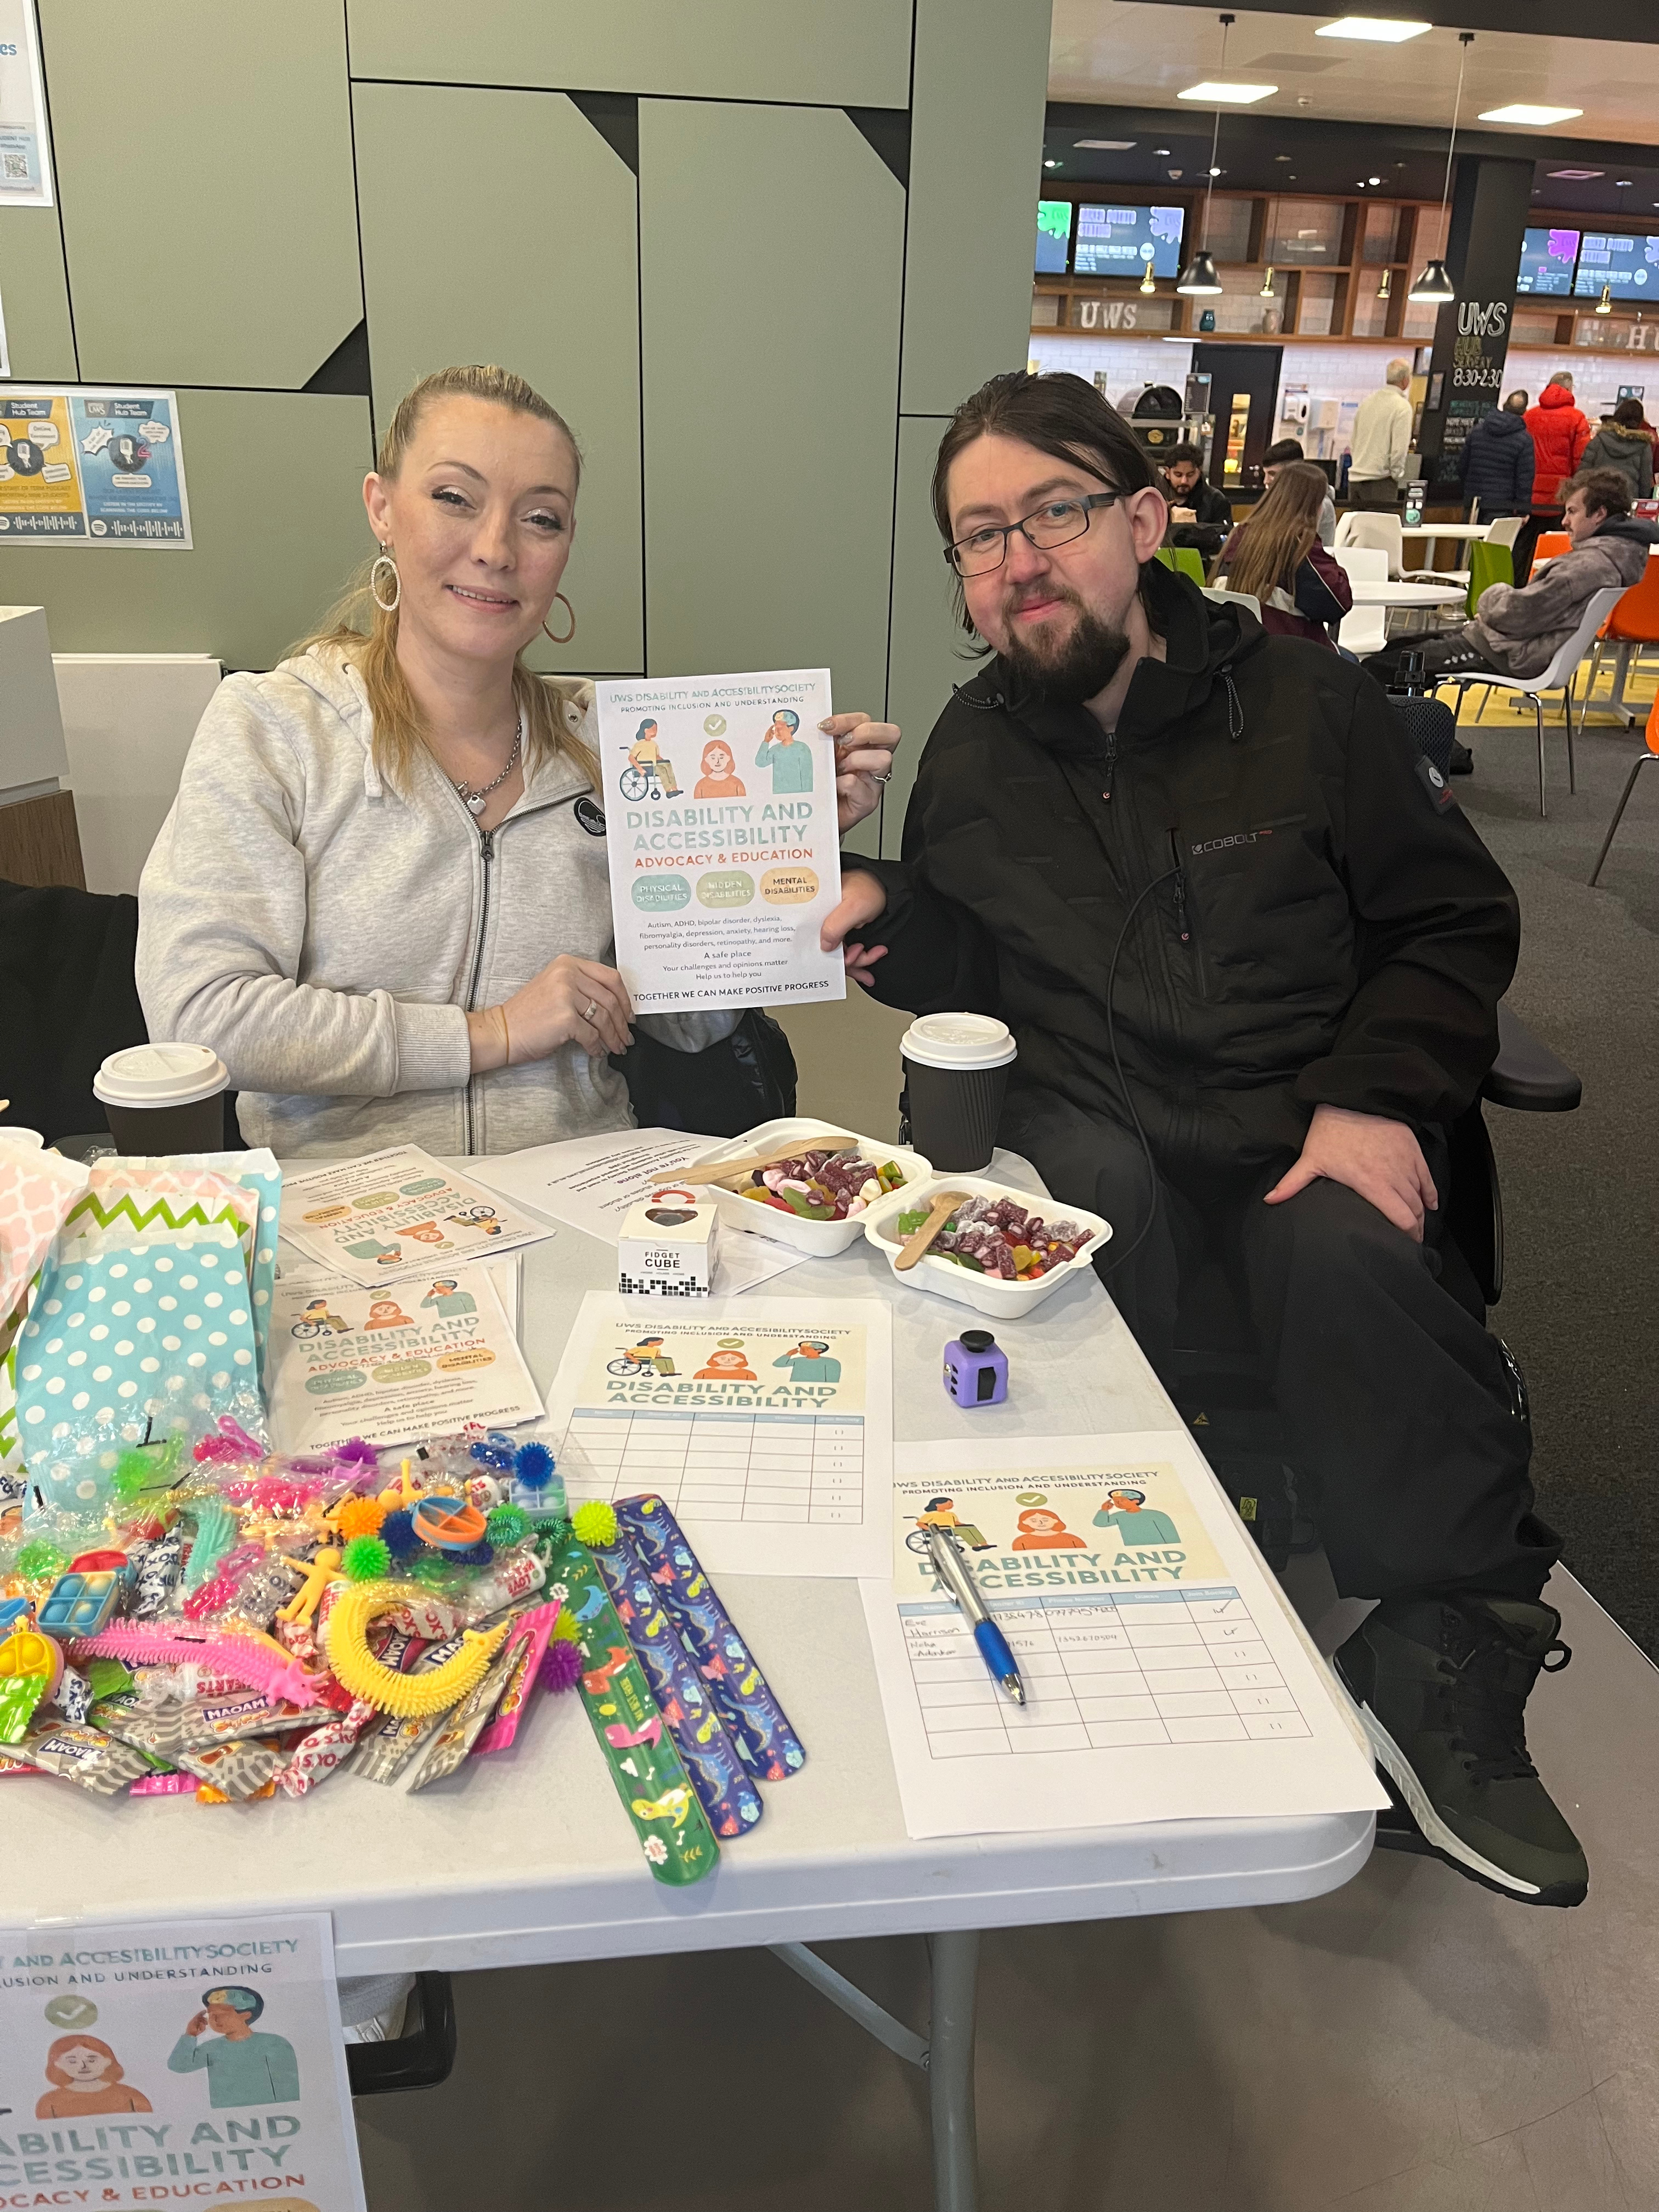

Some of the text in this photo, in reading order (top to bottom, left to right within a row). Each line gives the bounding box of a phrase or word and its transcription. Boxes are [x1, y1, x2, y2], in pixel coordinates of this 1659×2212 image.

[1080, 301, 1137, 329] UWS
[1458, 302, 1508, 337] UWS
[610, 695, 633, 703] UWS
[636, 691, 689, 702] DISABILITY
[692, 689, 709, 698] AND
[621, 704, 665, 713] PROMOTING
[669, 702, 710, 710] INCLUSION
[735, 696, 804, 707] UNDERSTANDING
[627, 802, 813, 829] DISABILITY AND
[633, 825, 808, 851] ACCESSIBILITY
[1204, 832, 1258, 852] COBOLT
[635, 848, 812, 868] ADVOCACY & EDUCATION
[640, 884, 682, 893] PHYSICAL
[708, 881, 742, 889] HIDDEN
[773, 877, 807, 885] MENTAL
[636, 893, 687, 903] DISABILITIES
[701, 889, 751, 899] DISABILITIES
[765, 885, 815, 895] DISABILITIES
[698, 918, 721, 927] bipolar
[753, 916, 782, 924] dyslexia,
[639, 931, 684, 940] fibromyalgia,
[686, 929, 725, 939] depression,
[754, 925, 779, 935] hearing
[644, 941, 681, 951] personality
[717, 938, 757, 947] retinopathy,
[731, 950, 751, 959] place
[680, 962, 716, 972] challenges
[733, 960, 763, 969] opinions
[696, 973, 712, 981] Help
[732, 970, 747, 979] help
[634, 991, 680, 1001] TOGETHER
[697, 989, 716, 997] CAN
[719, 988, 743, 996] MAKE
[746, 985, 783, 994] POSITIVE
[785, 980, 828, 991] PROGRESS
[374, 1150, 407, 1162] TOGETHER
[659, 1156, 689, 1167] You're
[613, 1173, 642, 1184] alone.
[396, 1188, 453, 1207] ADVOCACY
[319, 1209, 382, 1230] EDUCATION
[333, 1193, 461, 1236] ACCESSIBILITY
[334, 1198, 477, 1244] DISABILITY AND
[645, 1259, 680, 1268] CUBE
[300, 1316, 479, 1352] DISABILITY AND
[306, 1327, 477, 1363] ACCESSIBILITY
[308, 1355, 386, 1372] ADVOCACY
[406, 1338, 486, 1357] EDUCATION
[606, 1379, 837, 1397] DISABILITY AND
[607, 1392, 830, 1408] ACCESSIBILITY
[380, 1428, 400, 1436] CAN
[403, 1423, 430, 1432] MAKE
[431, 1415, 471, 1427] POSITIVE
[473, 1406, 521, 1419] PROGRESS
[902, 1486, 963, 1495] PROMOTING
[1054, 1479, 1147, 1488] UNDERSTANDING
[921, 1478, 991, 1487] DISABILITY
[1114, 1550, 1186, 1566] AND
[431, 1636, 464, 1663] MAO
[207, 1699, 265, 1720] MAOAM
[13, 1956, 53, 1967] AND
[0, 1963, 272, 1987] USION AND UNDERSTANDING
[190, 2115, 301, 2145] AND
[100, 2188, 120, 2202] &
[132, 2174, 305, 2201] EDUCATION
